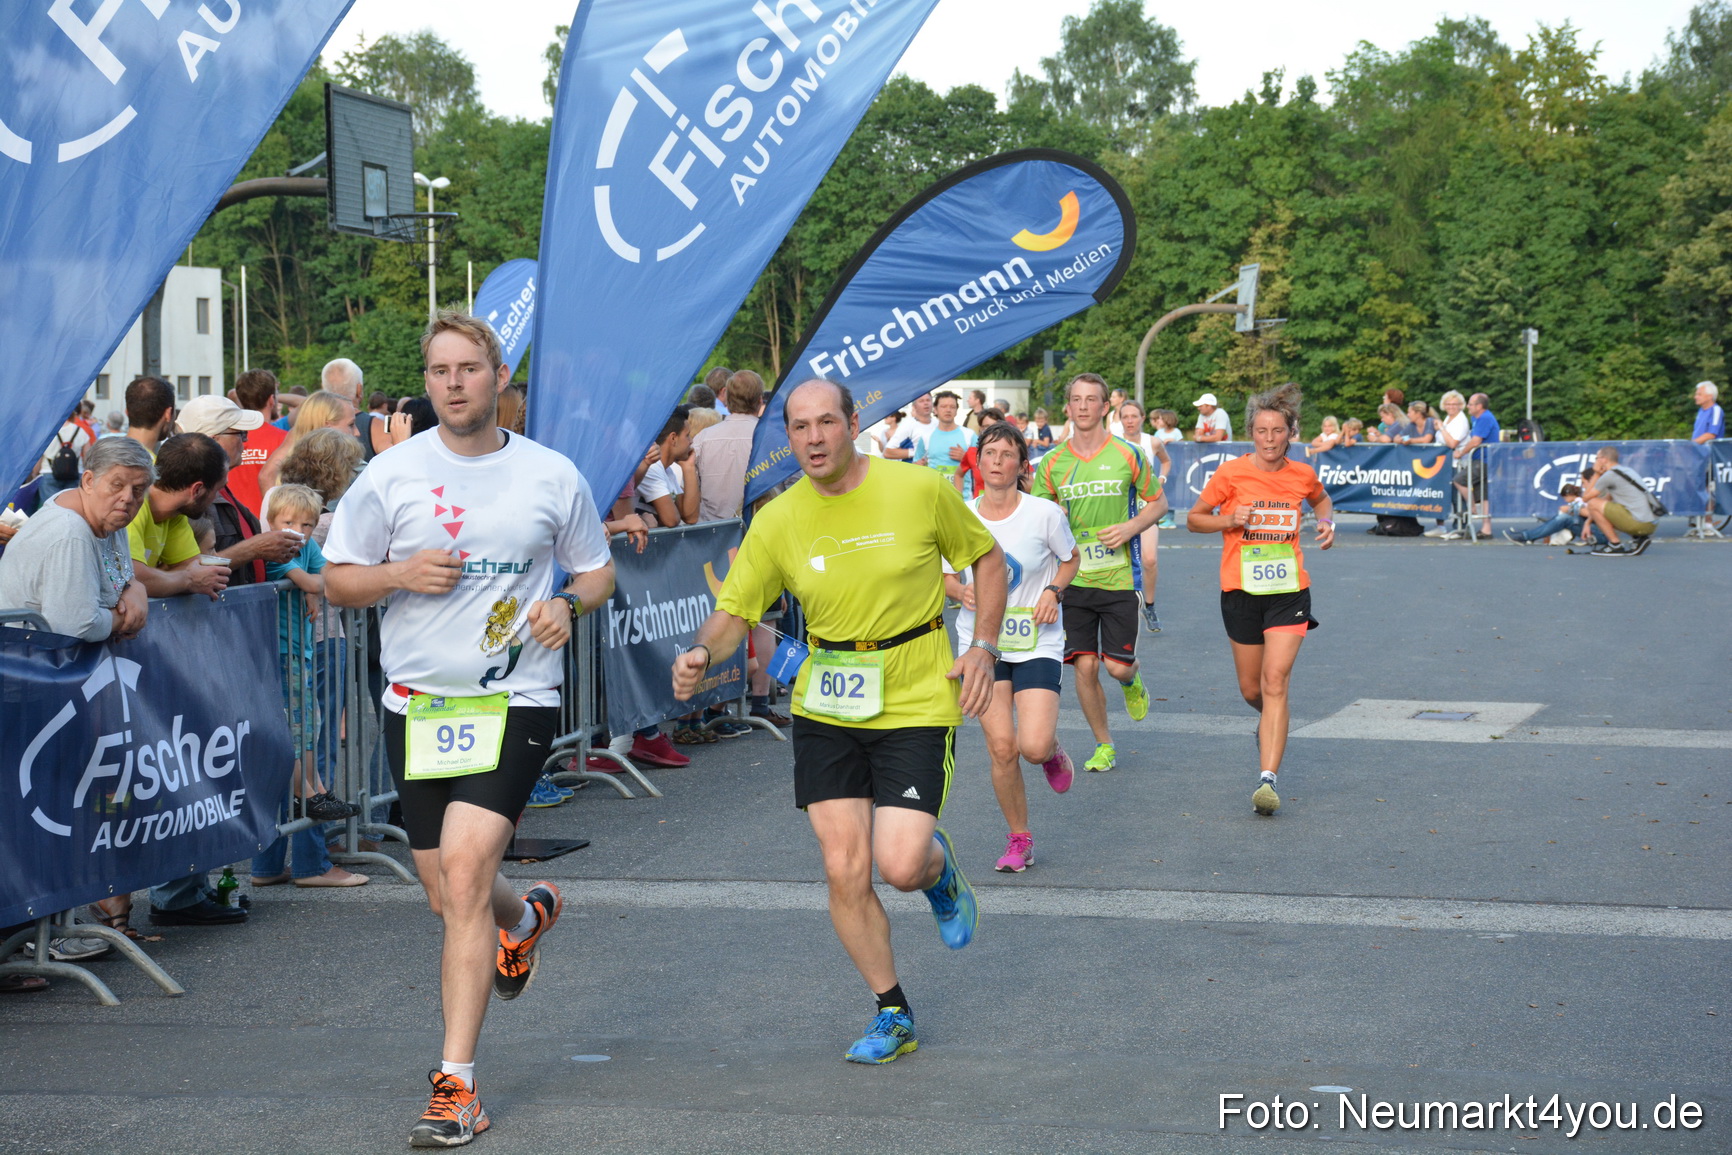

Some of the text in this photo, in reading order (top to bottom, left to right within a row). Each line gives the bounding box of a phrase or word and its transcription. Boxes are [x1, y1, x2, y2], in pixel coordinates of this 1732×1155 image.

[729, 0, 879, 207] AUTOMOBI
[954, 242, 1112, 335] Druck und Medien
[497, 276, 536, 346] ischer
[808, 256, 1034, 379] Frischmann
[1318, 464, 1413, 486] Frischmann
[1557, 472, 1672, 494] Fier
[1252, 500, 1290, 509] 30 Jahre
[1371, 486, 1396, 497] Druck
[1413, 488, 1444, 499] Medien
[1248, 513, 1294, 526] OBI
[1242, 530, 1296, 542] Neumarkt
[1084, 544, 1116, 560] 154
[1252, 563, 1288, 581] 566
[607, 590, 711, 649] Frischmann
[820, 671, 865, 698] 602
[436, 723, 476, 754] 95
[73, 714, 250, 808] Fischer
[90, 788, 246, 854] AUTOMOBILE
